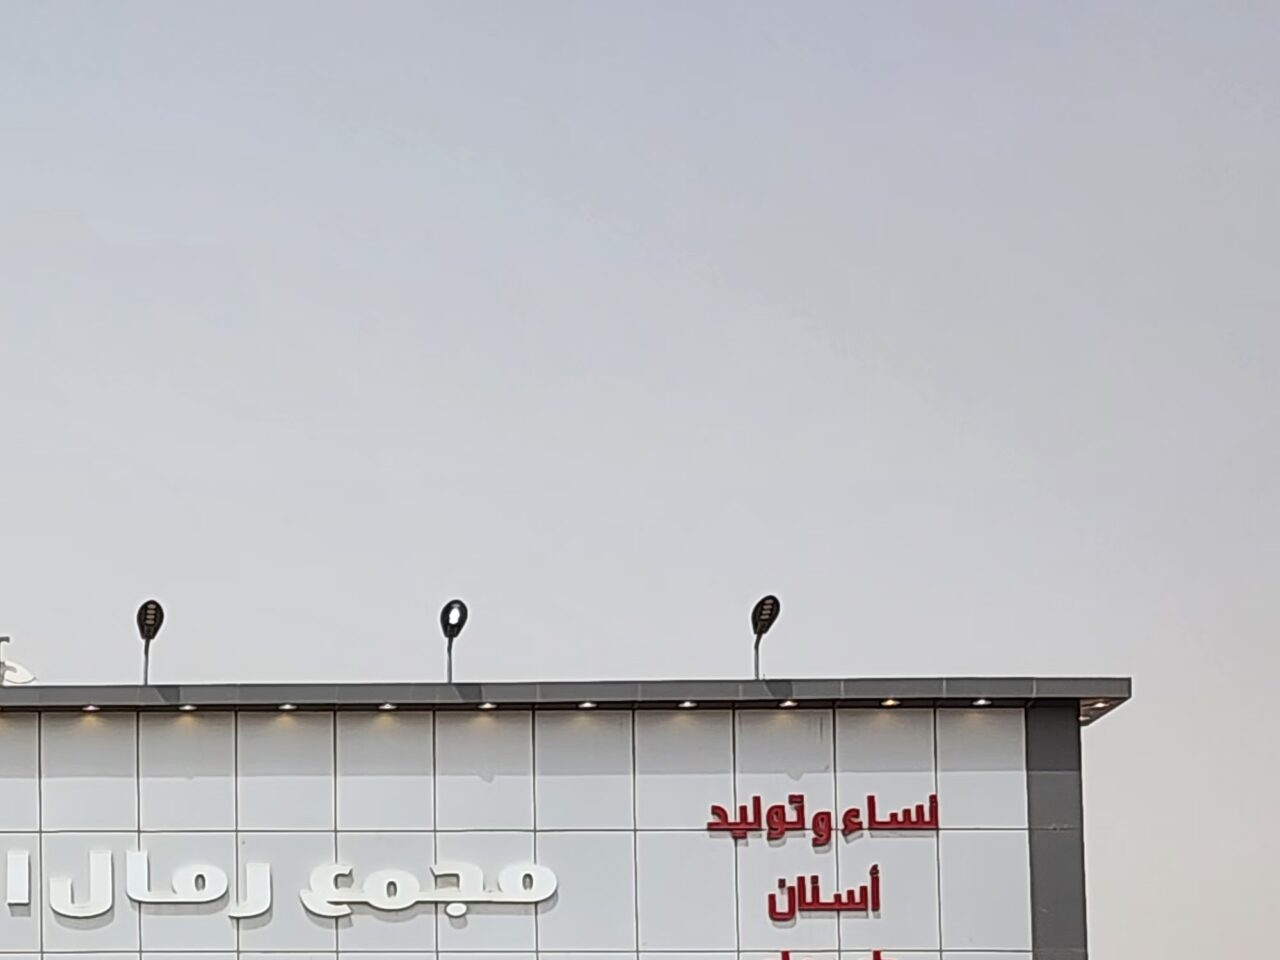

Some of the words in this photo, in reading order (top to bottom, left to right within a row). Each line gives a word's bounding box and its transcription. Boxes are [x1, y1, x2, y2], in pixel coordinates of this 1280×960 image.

[840, 793, 940, 838] نساء
[48, 849, 273, 920] رمال
[299, 860, 558, 919] مجمع
[768, 864, 881, 922] أسنان
